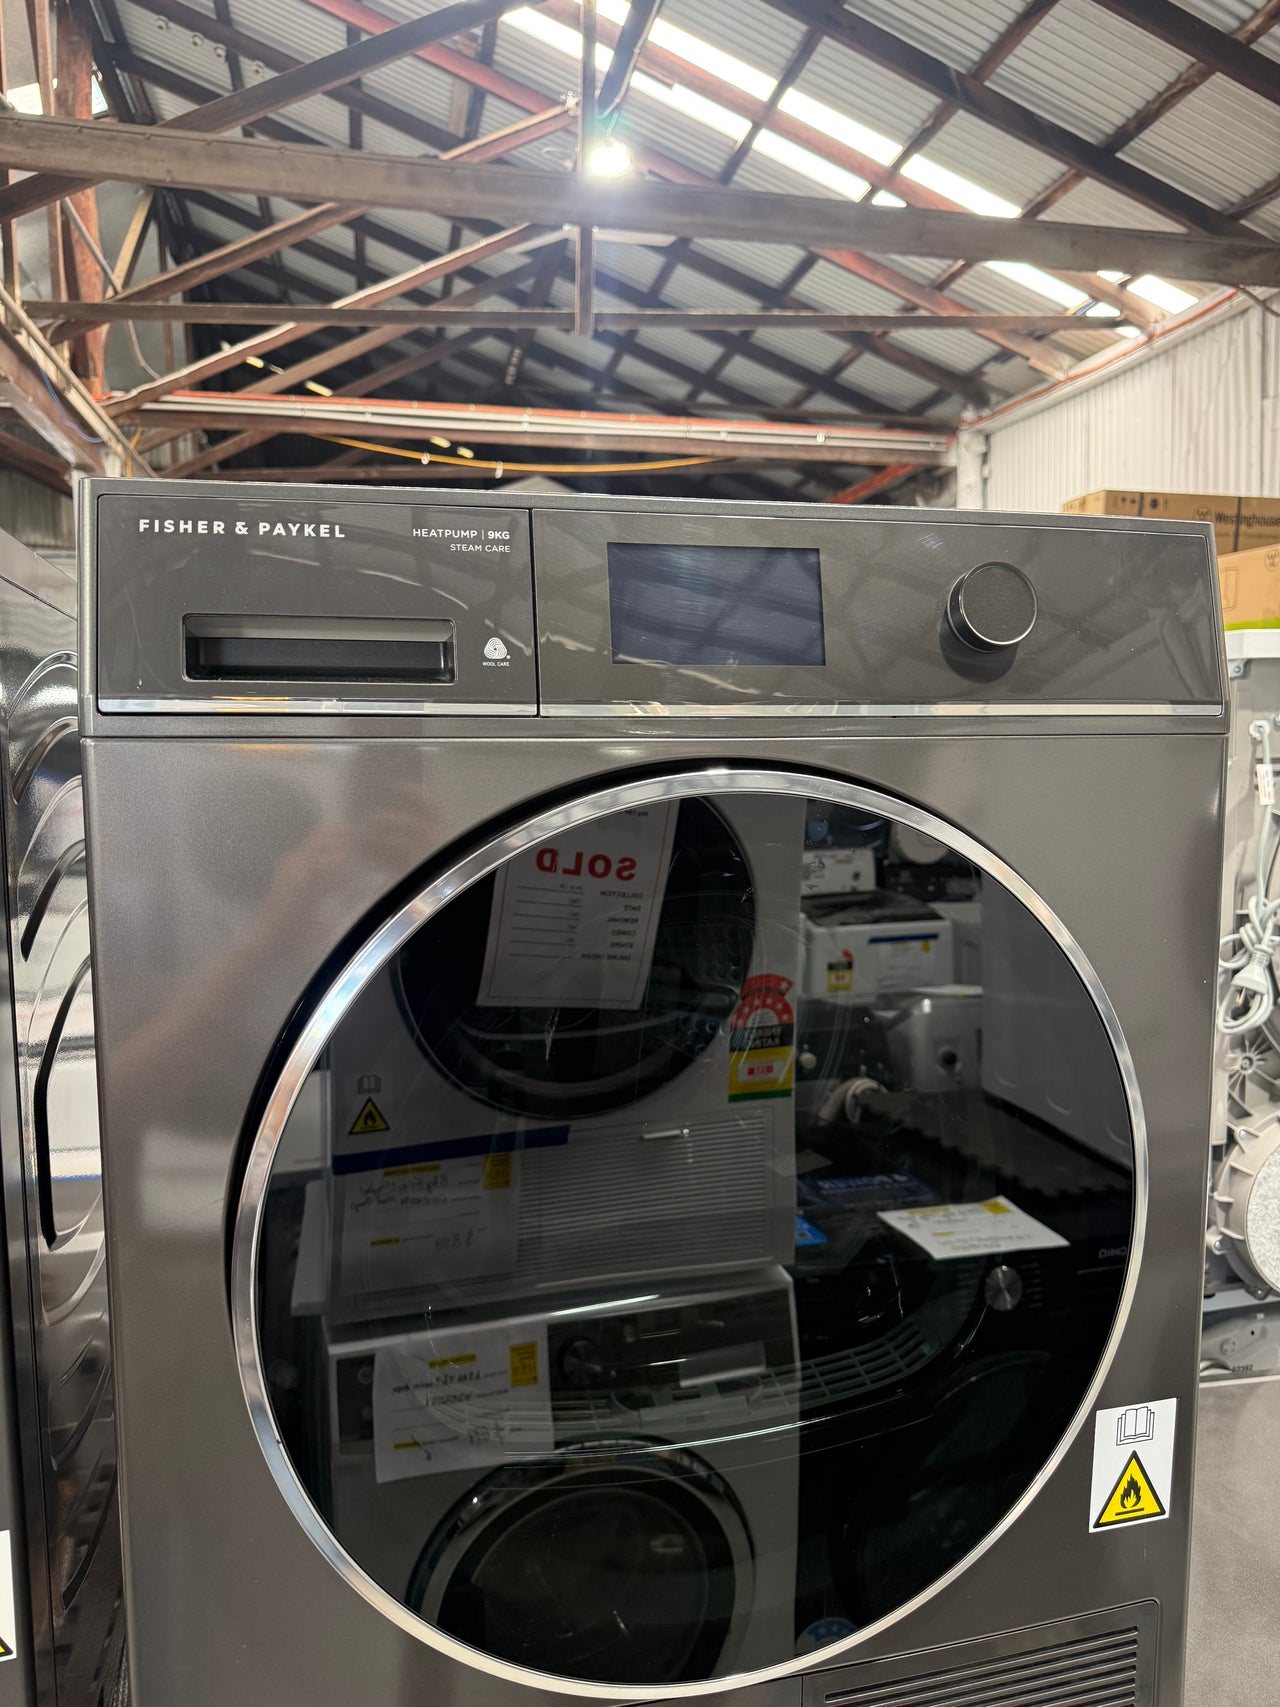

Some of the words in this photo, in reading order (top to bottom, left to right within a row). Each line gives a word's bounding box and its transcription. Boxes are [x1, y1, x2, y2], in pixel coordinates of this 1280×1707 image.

[1214, 510, 1280, 528] Wesinghouse
[138, 519, 225, 535] FISHER
[234, 521, 249, 535] &
[258, 522, 346, 538] PAYKEL
[412, 528, 478, 539] HEATPUMP
[487, 530, 511, 540] 9KG
[450, 543, 482, 552] STEAM
[485, 545, 511, 553] CARE
